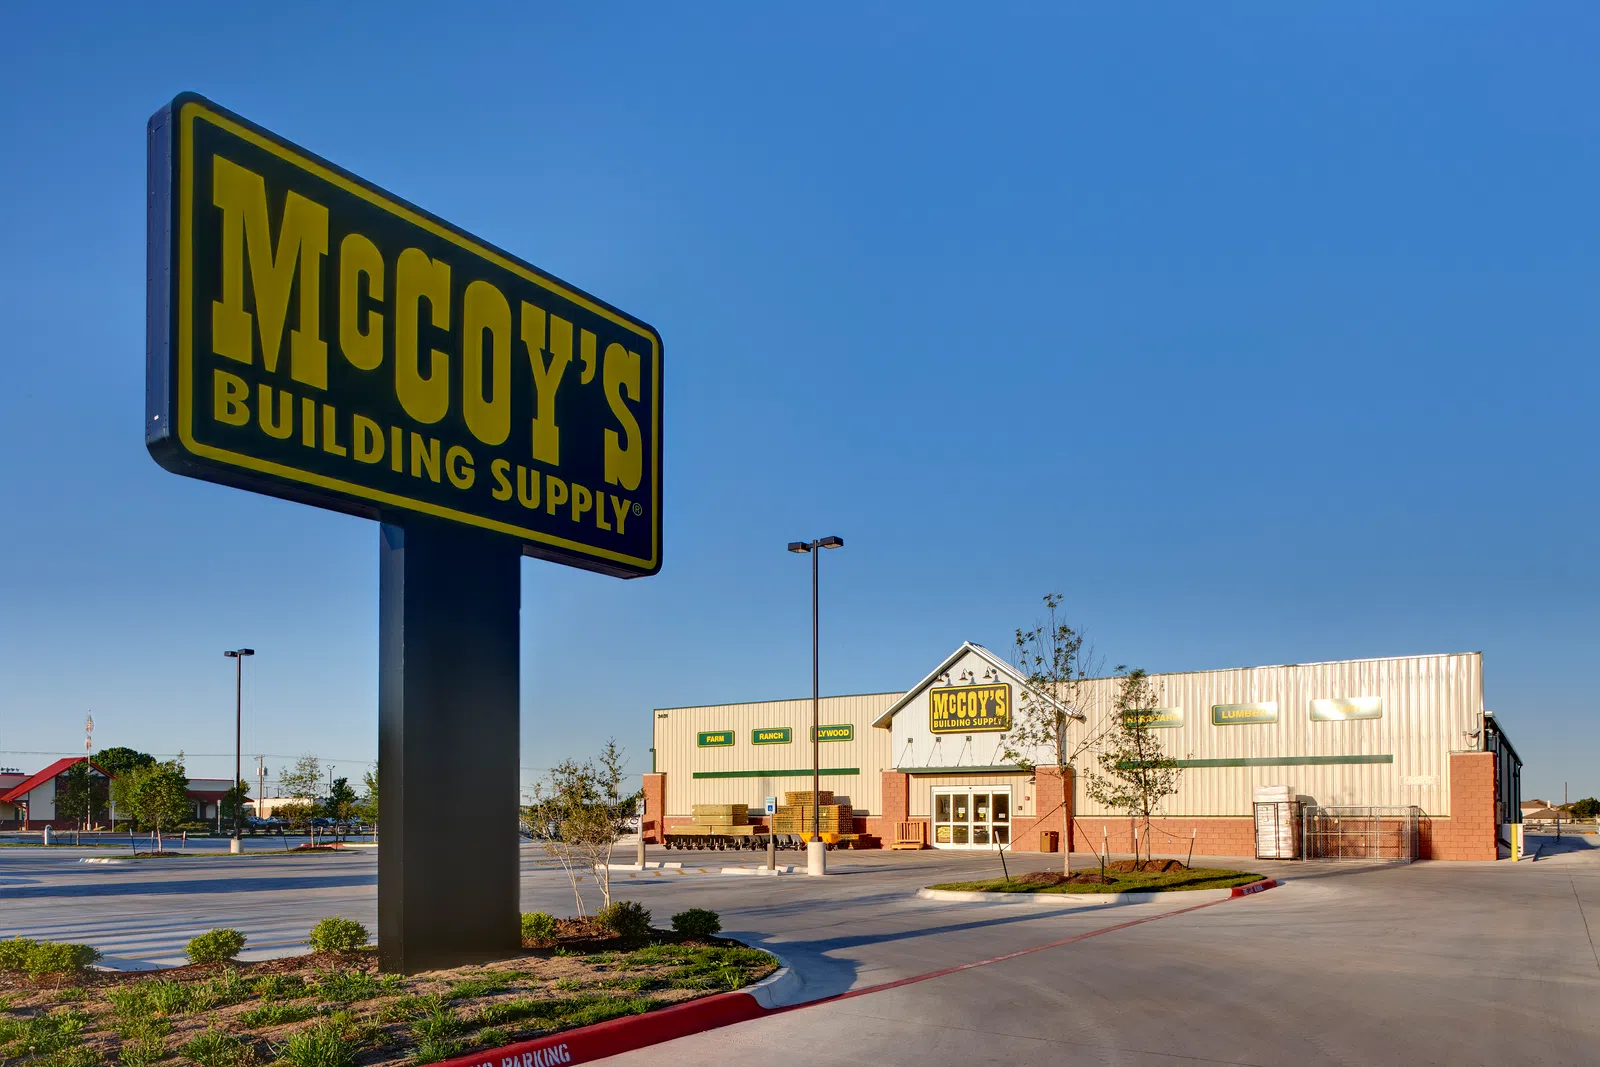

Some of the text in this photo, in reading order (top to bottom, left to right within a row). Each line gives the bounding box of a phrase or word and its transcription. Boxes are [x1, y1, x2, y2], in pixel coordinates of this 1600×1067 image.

[213, 368, 476, 490] BUILDING
[933, 719, 971, 728] BUILDING
[759, 732, 784, 741] RANCH
[817, 729, 850, 738] LYWOOD
[706, 735, 725, 743] FARM
